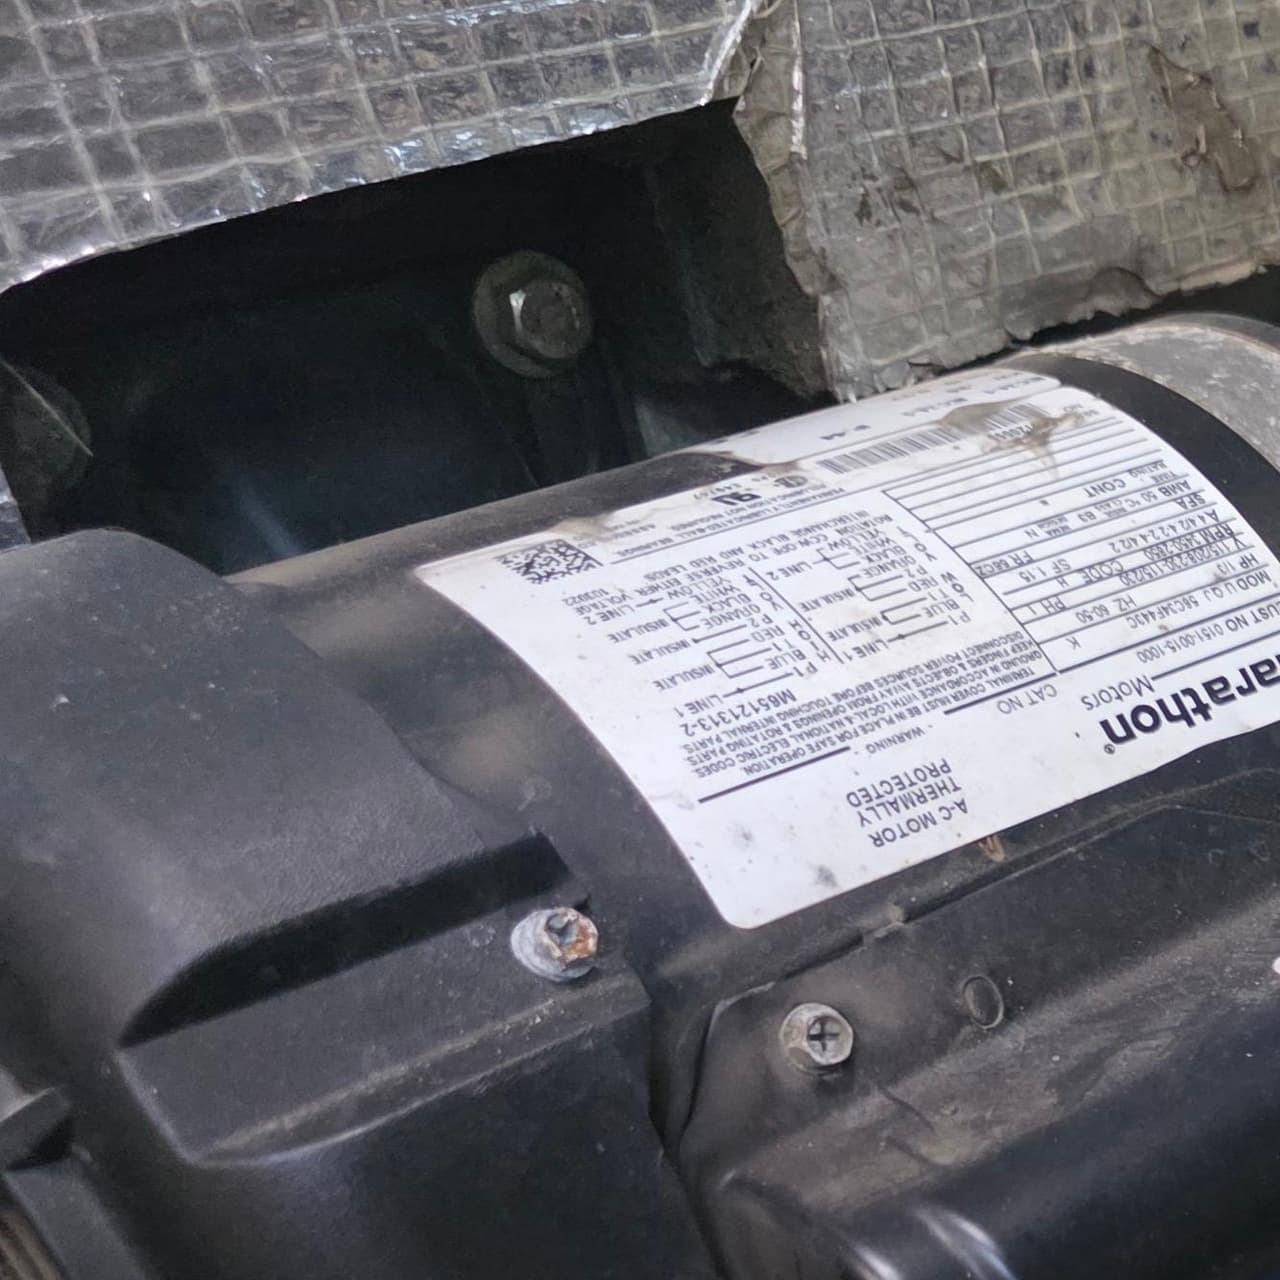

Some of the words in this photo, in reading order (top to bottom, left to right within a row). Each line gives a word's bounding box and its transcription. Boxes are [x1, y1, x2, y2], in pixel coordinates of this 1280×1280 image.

[1082, 477, 1126, 498] CONT
[1157, 478, 1191, 498] AMB
[1173, 491, 1205, 511] SFA
[1203, 507, 1219, 523] A
[826, 526, 885, 552] YELLOW
[1198, 522, 1233, 543] RPM
[747, 550, 768, 562] TO
[860, 543, 906, 565] BLACK
[1007, 549, 1033, 566] FR
[1049, 557, 1071, 573] SF
[1235, 552, 1259, 569] HP
[776, 559, 812, 578] LINE
[860, 552, 917, 580] ORANGE
[1076, 558, 1124, 583] CODE
[1215, 559, 1236, 576] 1/3
[665, 574, 730, 600] YELLOW
[906, 574, 938, 594] RED
[1235, 568, 1271, 591] MOD
[572, 592, 632, 616] VOLTAGE
[688, 581, 740, 605] WHITE
[700, 591, 751, 614] BLACK
[796, 586, 856, 613] INSULATE
[1111, 593, 1137, 612] HZ
[593, 602, 634, 623] LINE
[699, 601, 761, 630] ORANGE
[921, 596, 959, 618] BLUE
[1038, 595, 1065, 614] PH
[1073, 602, 1110, 624] 60-50
[605, 616, 670, 644] INSULATE
[749, 623, 785, 643] RED
[824, 615, 883, 642] INSULATE
[1223, 612, 1248, 632] NO
[627, 638, 691, 665] INSULATE
[850, 637, 889, 658] LINE
[1064, 635, 1081, 650] K
[764, 647, 806, 670] BLUE
[988, 662, 1002, 675] IN
[999, 648, 1042, 671] GROUND
[652, 662, 715, 692] INSULATE
[918, 667, 989, 699] ACCORDANCE
[986, 665, 1034, 689] TERMINAL
[950, 682, 986, 702] COVER
[1024, 681, 1058, 705] CAT
[1078, 673, 1155, 713] Motors
[683, 693, 723, 715] LINE
[854, 701, 891, 722] LOCAL
[905, 705, 921, 718] BE
[921, 695, 952, 712] MUST
[994, 694, 1023, 716] NO
[858, 715, 895, 734] PLACE
[893, 711, 907, 722] IN
[788, 718, 844, 745] NATIONAL
[834, 727, 859, 743] FOR
[864, 724, 925, 755] WARNING
[734, 737, 790, 764] ELECTRIC
[805, 736, 835, 753] SAFE
[844, 756, 952, 809] PROTECTED
[854, 774, 962, 827] THERMALLY
[937, 797, 969, 822] A-C
[866, 809, 937, 849] MOTOR
